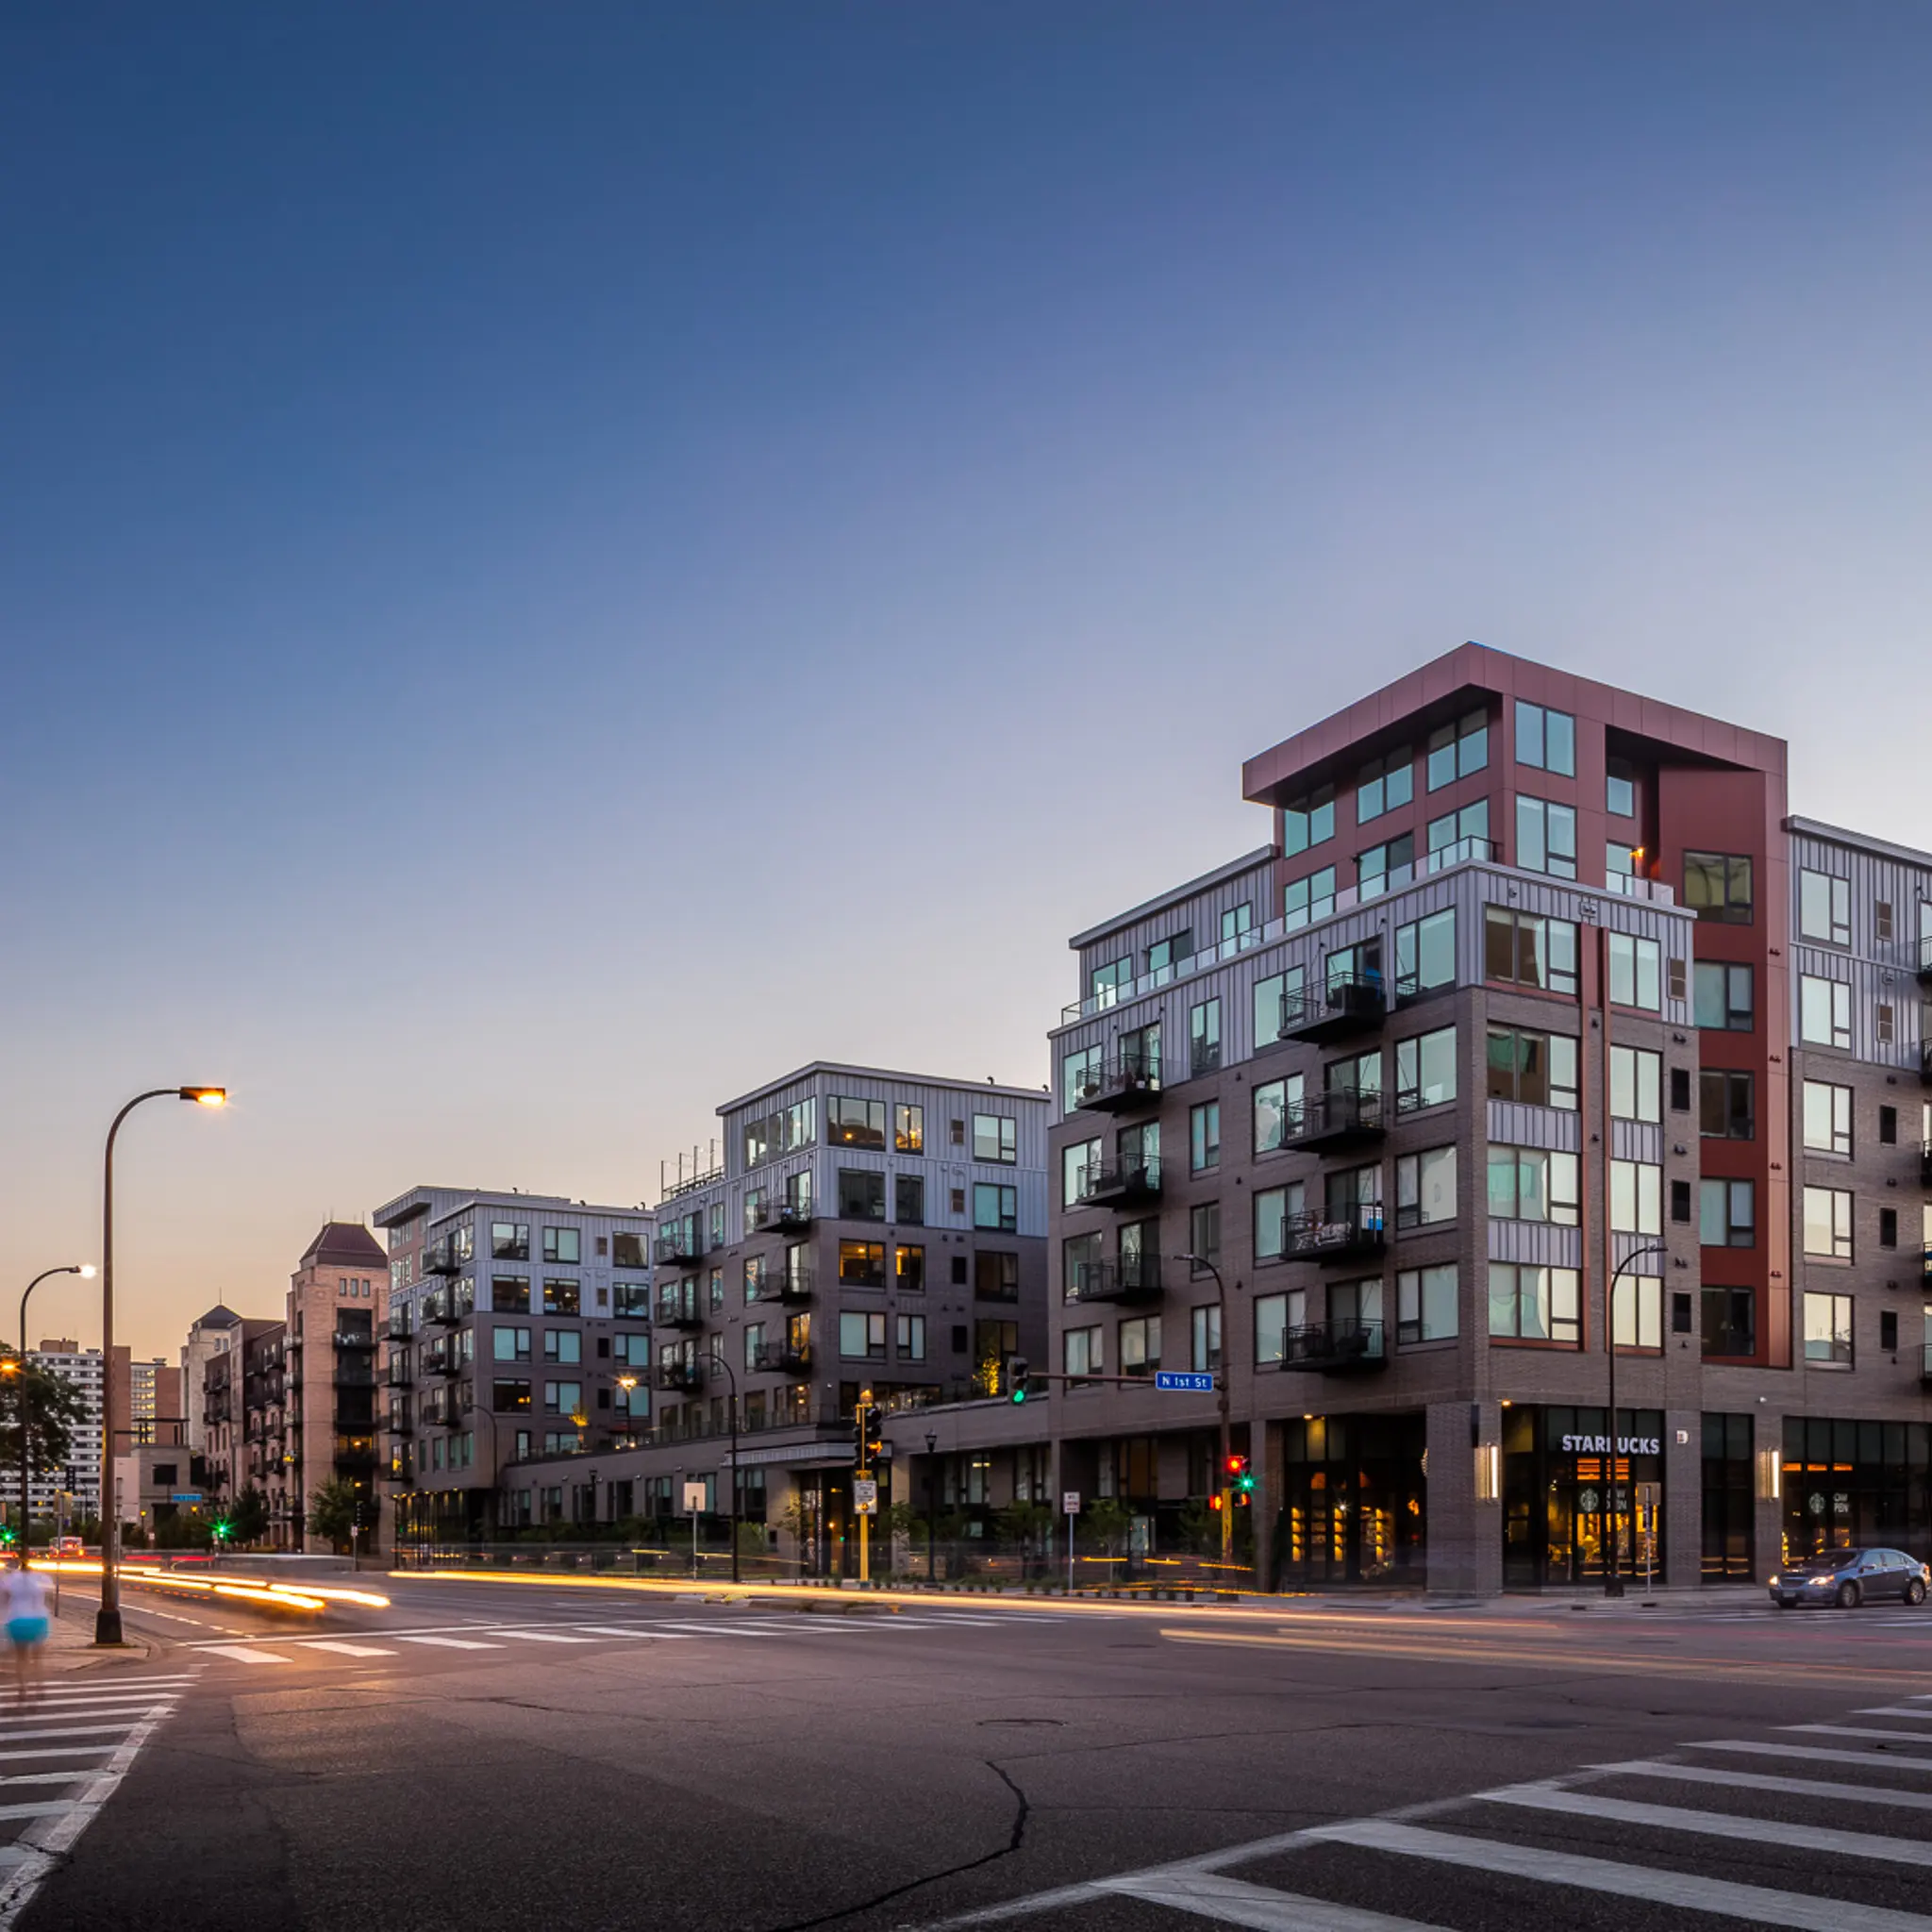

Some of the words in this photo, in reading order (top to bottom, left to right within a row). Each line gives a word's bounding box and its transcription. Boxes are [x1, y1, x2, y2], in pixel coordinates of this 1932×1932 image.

[1162, 1375, 1170, 1386] N
[1174, 1376, 1190, 1388] 1st
[1194, 1377, 1208, 1388] St
